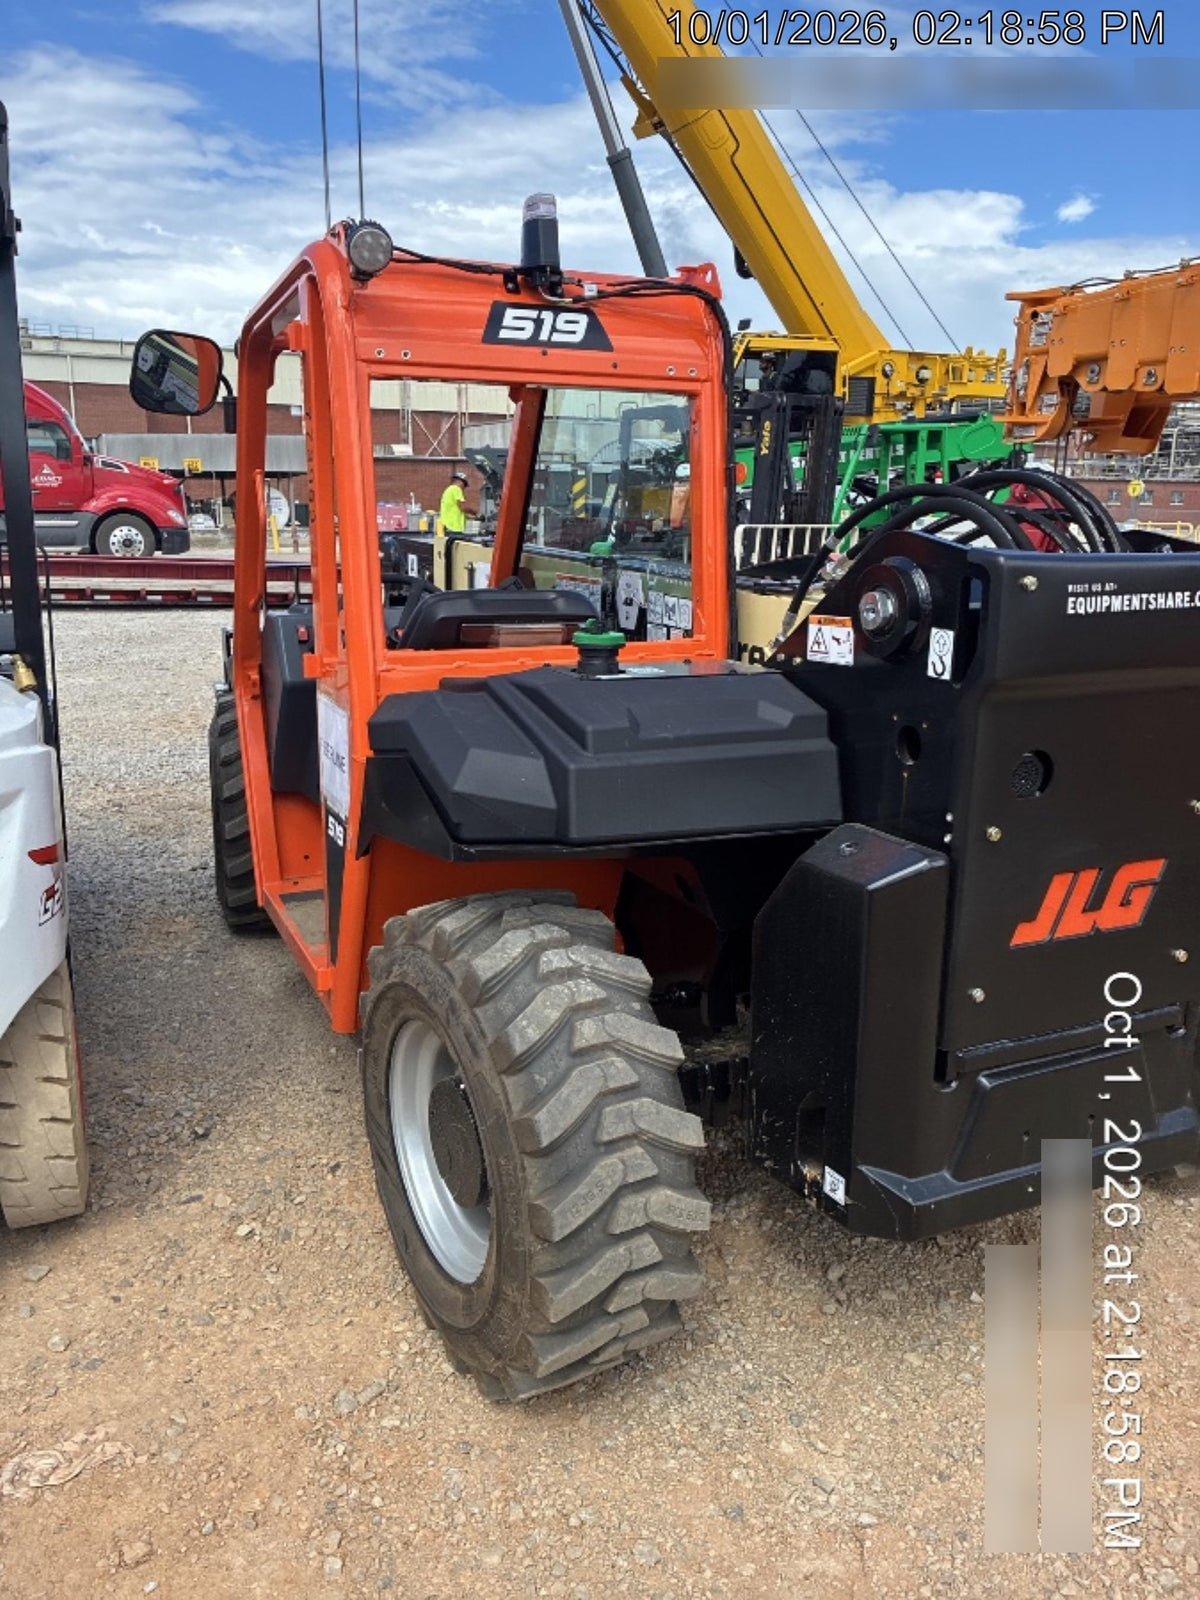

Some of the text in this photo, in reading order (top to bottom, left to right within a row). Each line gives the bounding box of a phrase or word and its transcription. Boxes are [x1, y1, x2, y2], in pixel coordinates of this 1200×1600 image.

[498, 307, 590, 343] 519
[760, 420, 771, 456] Yale
[1067, 584, 1089, 593] VISIT
[1091, 583, 1102, 592] US
[327, 814, 344, 848] 519
[1009, 857, 1168, 949] JLG
